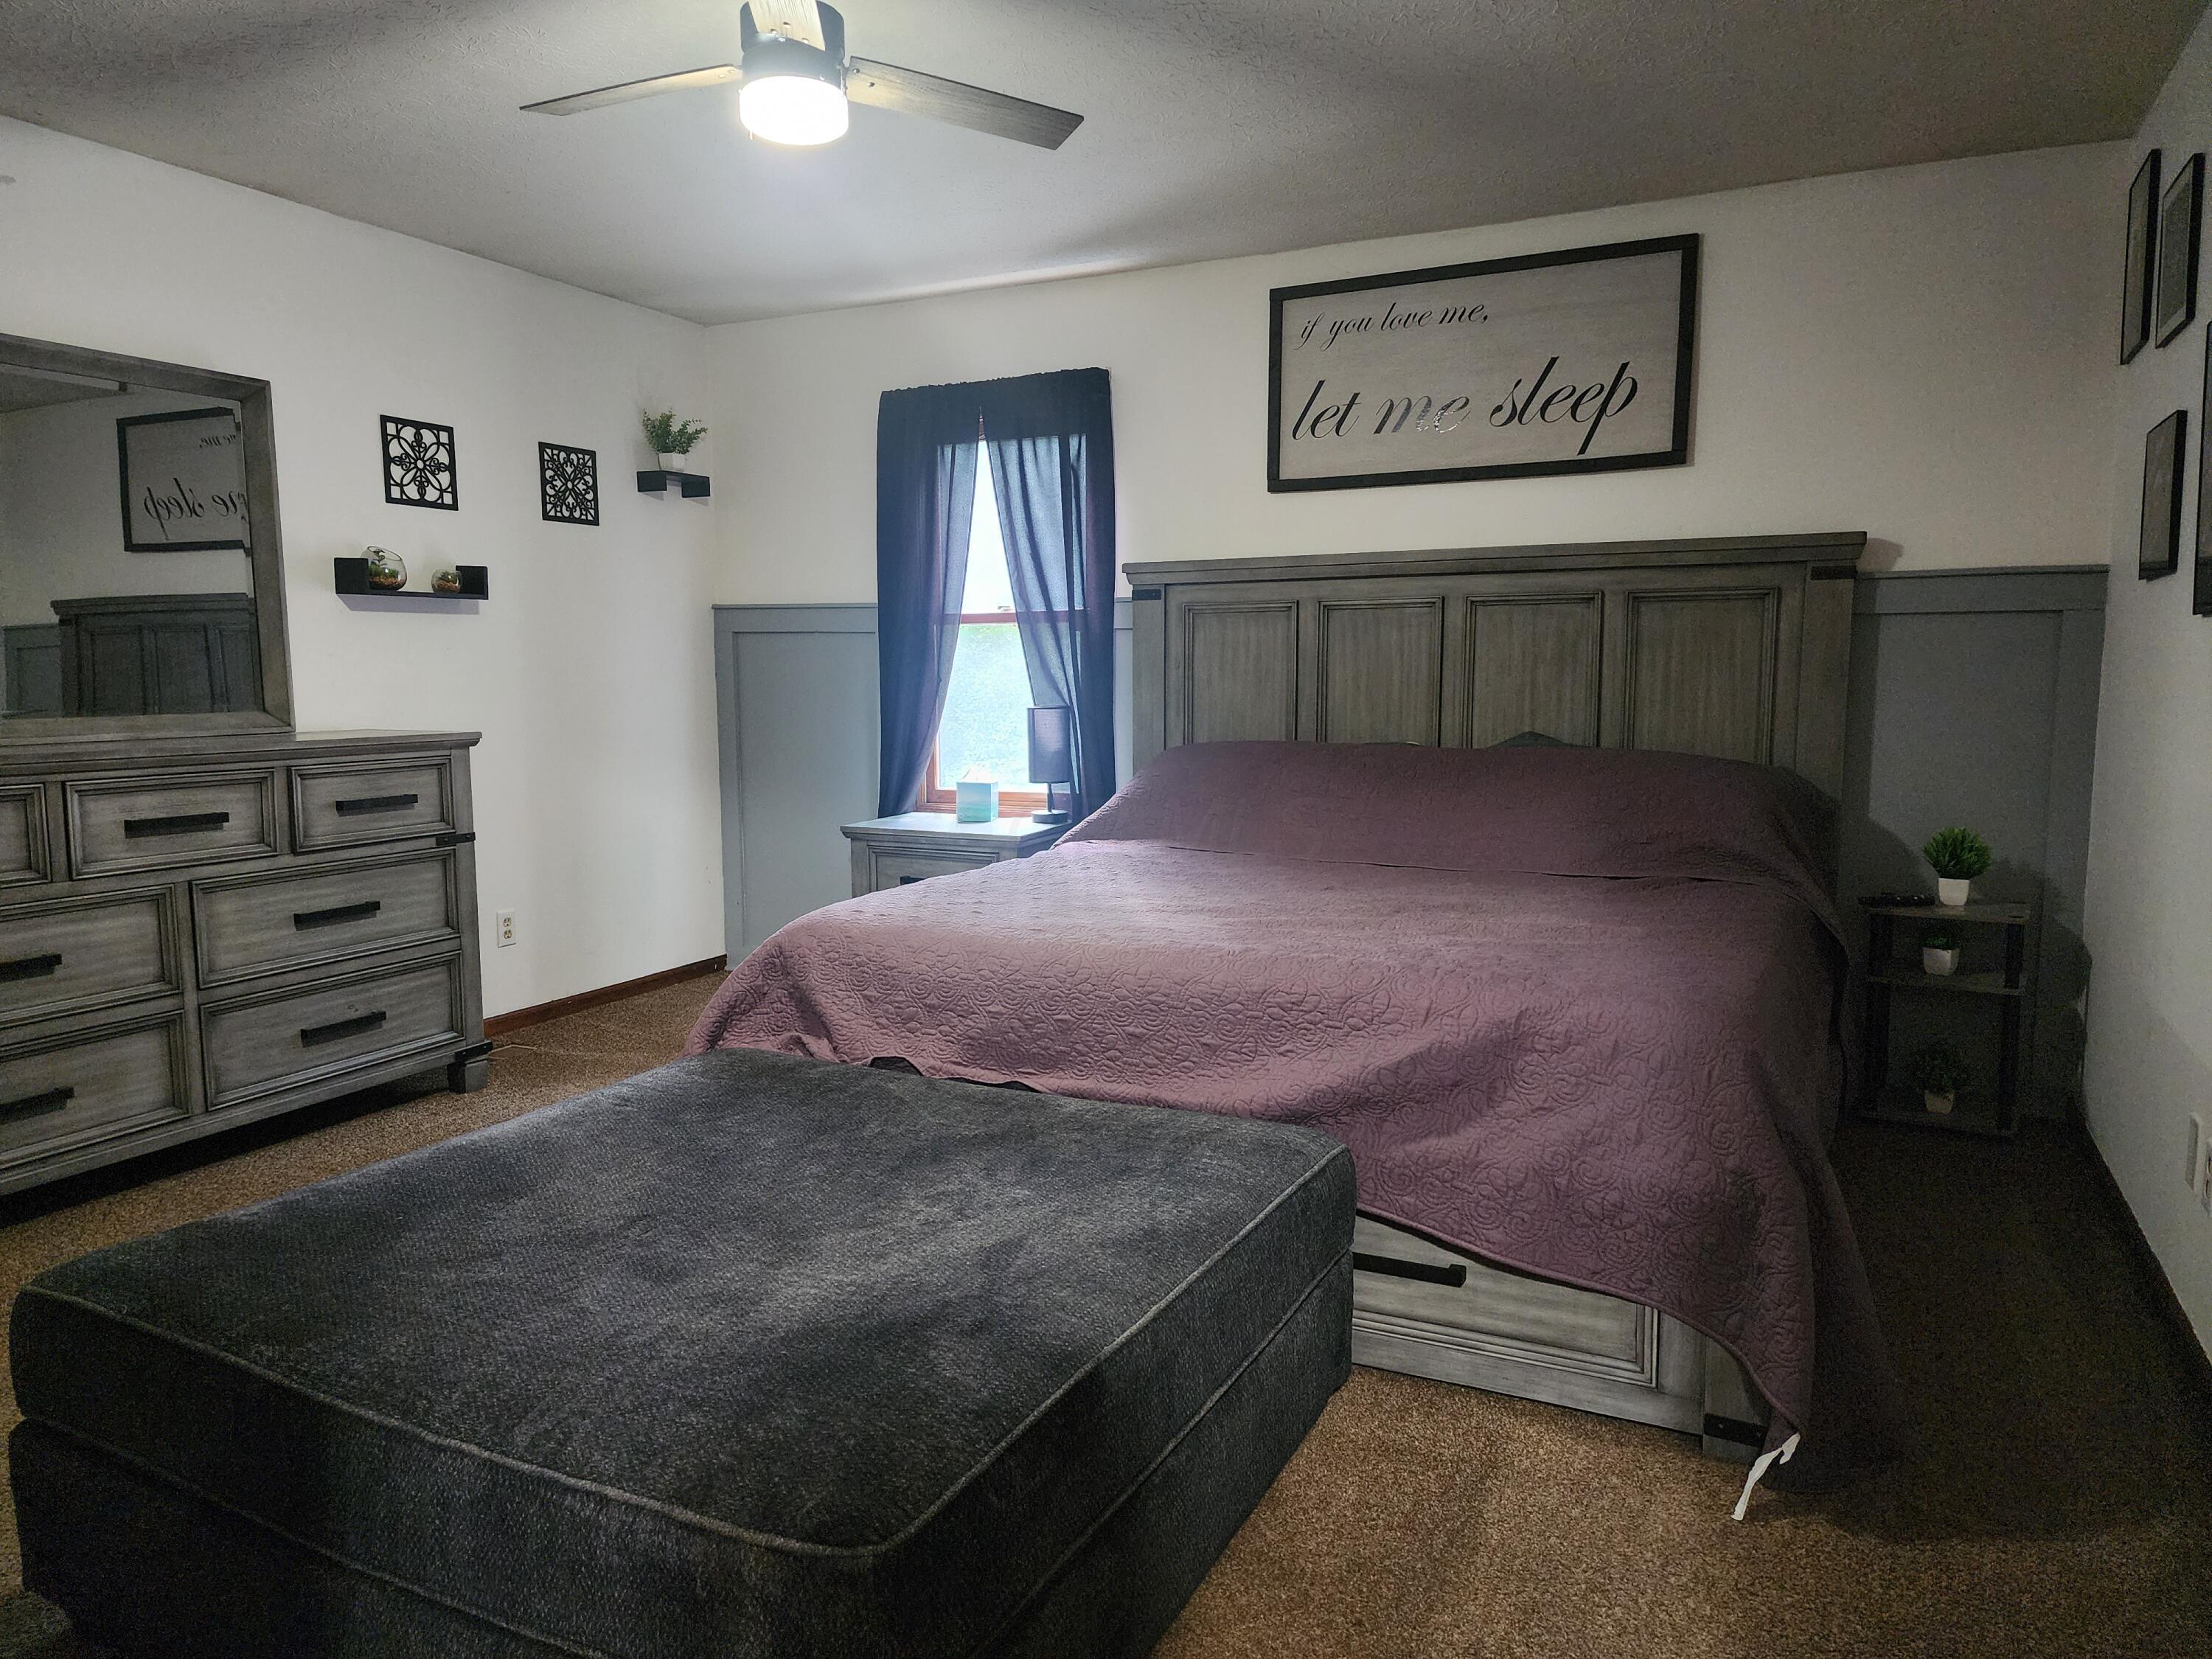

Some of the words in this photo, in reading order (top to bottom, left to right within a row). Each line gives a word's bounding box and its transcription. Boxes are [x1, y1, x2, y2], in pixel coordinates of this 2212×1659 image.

[1293, 312, 1326, 350] if
[1320, 316, 1374, 352] you
[1380, 302, 1433, 333] love
[1439, 304, 1489, 325] me,
[1292, 380, 1361, 441] let
[1373, 394, 1470, 436] me
[1489, 355, 1638, 456] sleep
